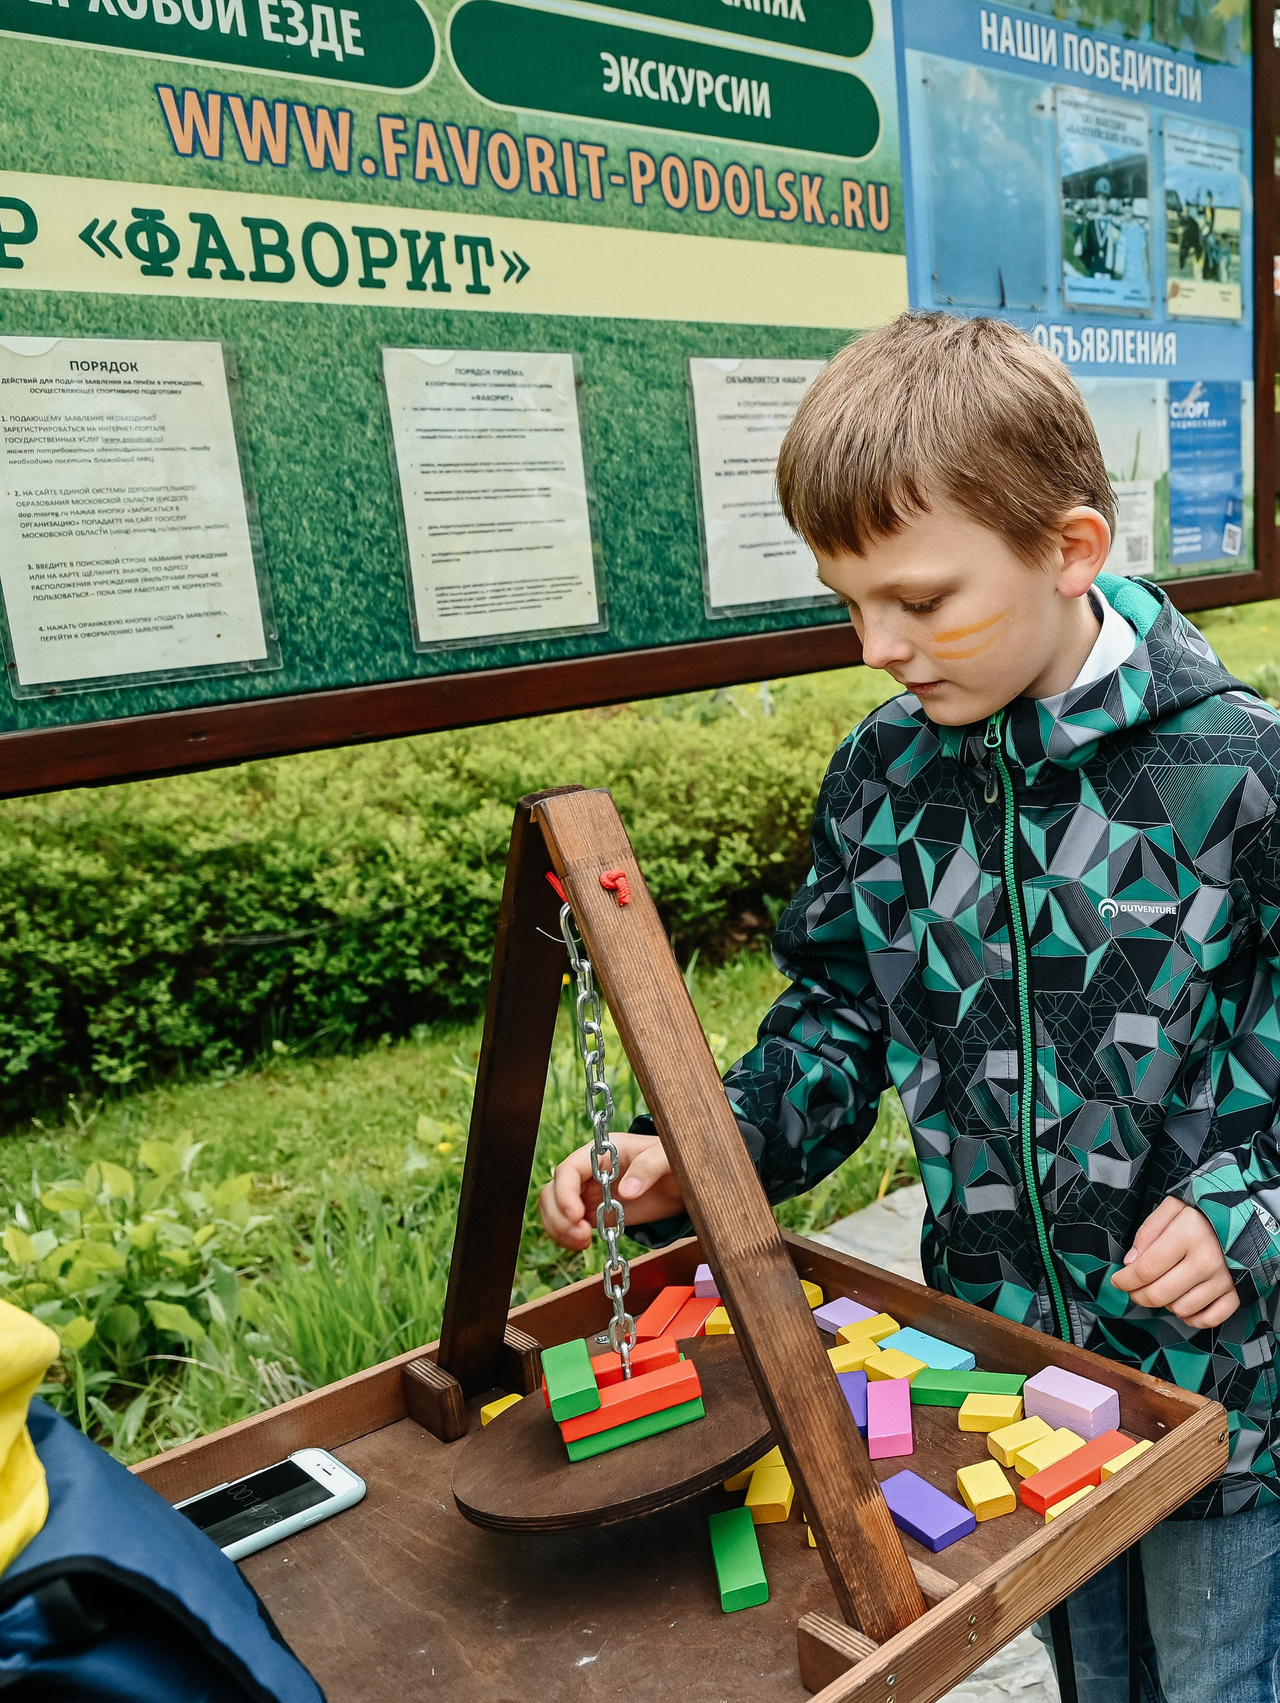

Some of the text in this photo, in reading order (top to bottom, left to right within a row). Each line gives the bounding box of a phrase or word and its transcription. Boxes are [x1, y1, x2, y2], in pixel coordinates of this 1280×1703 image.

[260, 0, 365, 62] ЕЗДЕ
[979, 9, 1203, 103] НАШИ ПОБЕДИТЕЛИ
[600, 51, 772, 119] ЭКСКУРСИИ
[155, 84, 890, 233] WWW.FAVORIT-PODOLSK.RU
[78, 207, 531, 296] «ФАВОРИТ»
[1033, 323, 1178, 366] ОБЪЯВЛЕНИЯ
[69, 360, 139, 374] ПОРЯДОК
[1, 377, 38, 385] ДЕЙСТВИЙ
[4, 436, 77, 444] ГОСУДАРСТВЕННЫХ
[34, 488, 58, 496] САЙТЕ
[59, 487, 90, 496] ЕДИНОЙ
[91, 487, 126, 495] СИСТЕМЫ
[16, 499, 70, 508] ОБРАЗОВАНИЯ
[71, 496, 121, 505] МОСКОВСКОЙ
[81, 517, 123, 526] ПОПАДАЕТЕ
[21, 530, 74, 539] МОСКОВСКОЙ
[74, 528, 109, 537] ОБЛАСТИ
[35, 561, 68, 570] ВВЕДИТЕ
[75, 557, 120, 567] ПОИСКОВОЙ
[30, 582, 92, 591] РАСПОЛОЖЕНИЯ
[92, 577, 139, 586] УЧРЕЖДЕНИЯ
[32, 591, 90, 602] ПОЛЬЗОВАТЬСЯ
[96, 589, 116, 597] ПОКА
[134, 585, 171, 594] РАБОТАЮТ
[46, 623, 77, 632] НАЖАТЬ
[77, 619, 124, 629] ОРАНЖЕВУЮ
[40, 633, 73, 642] ПЕРЕЙТИ
[80, 628, 134, 639] ОФОРМЛЕНИЮ
[1120, 904, 1177, 915] OUTVENTURE
